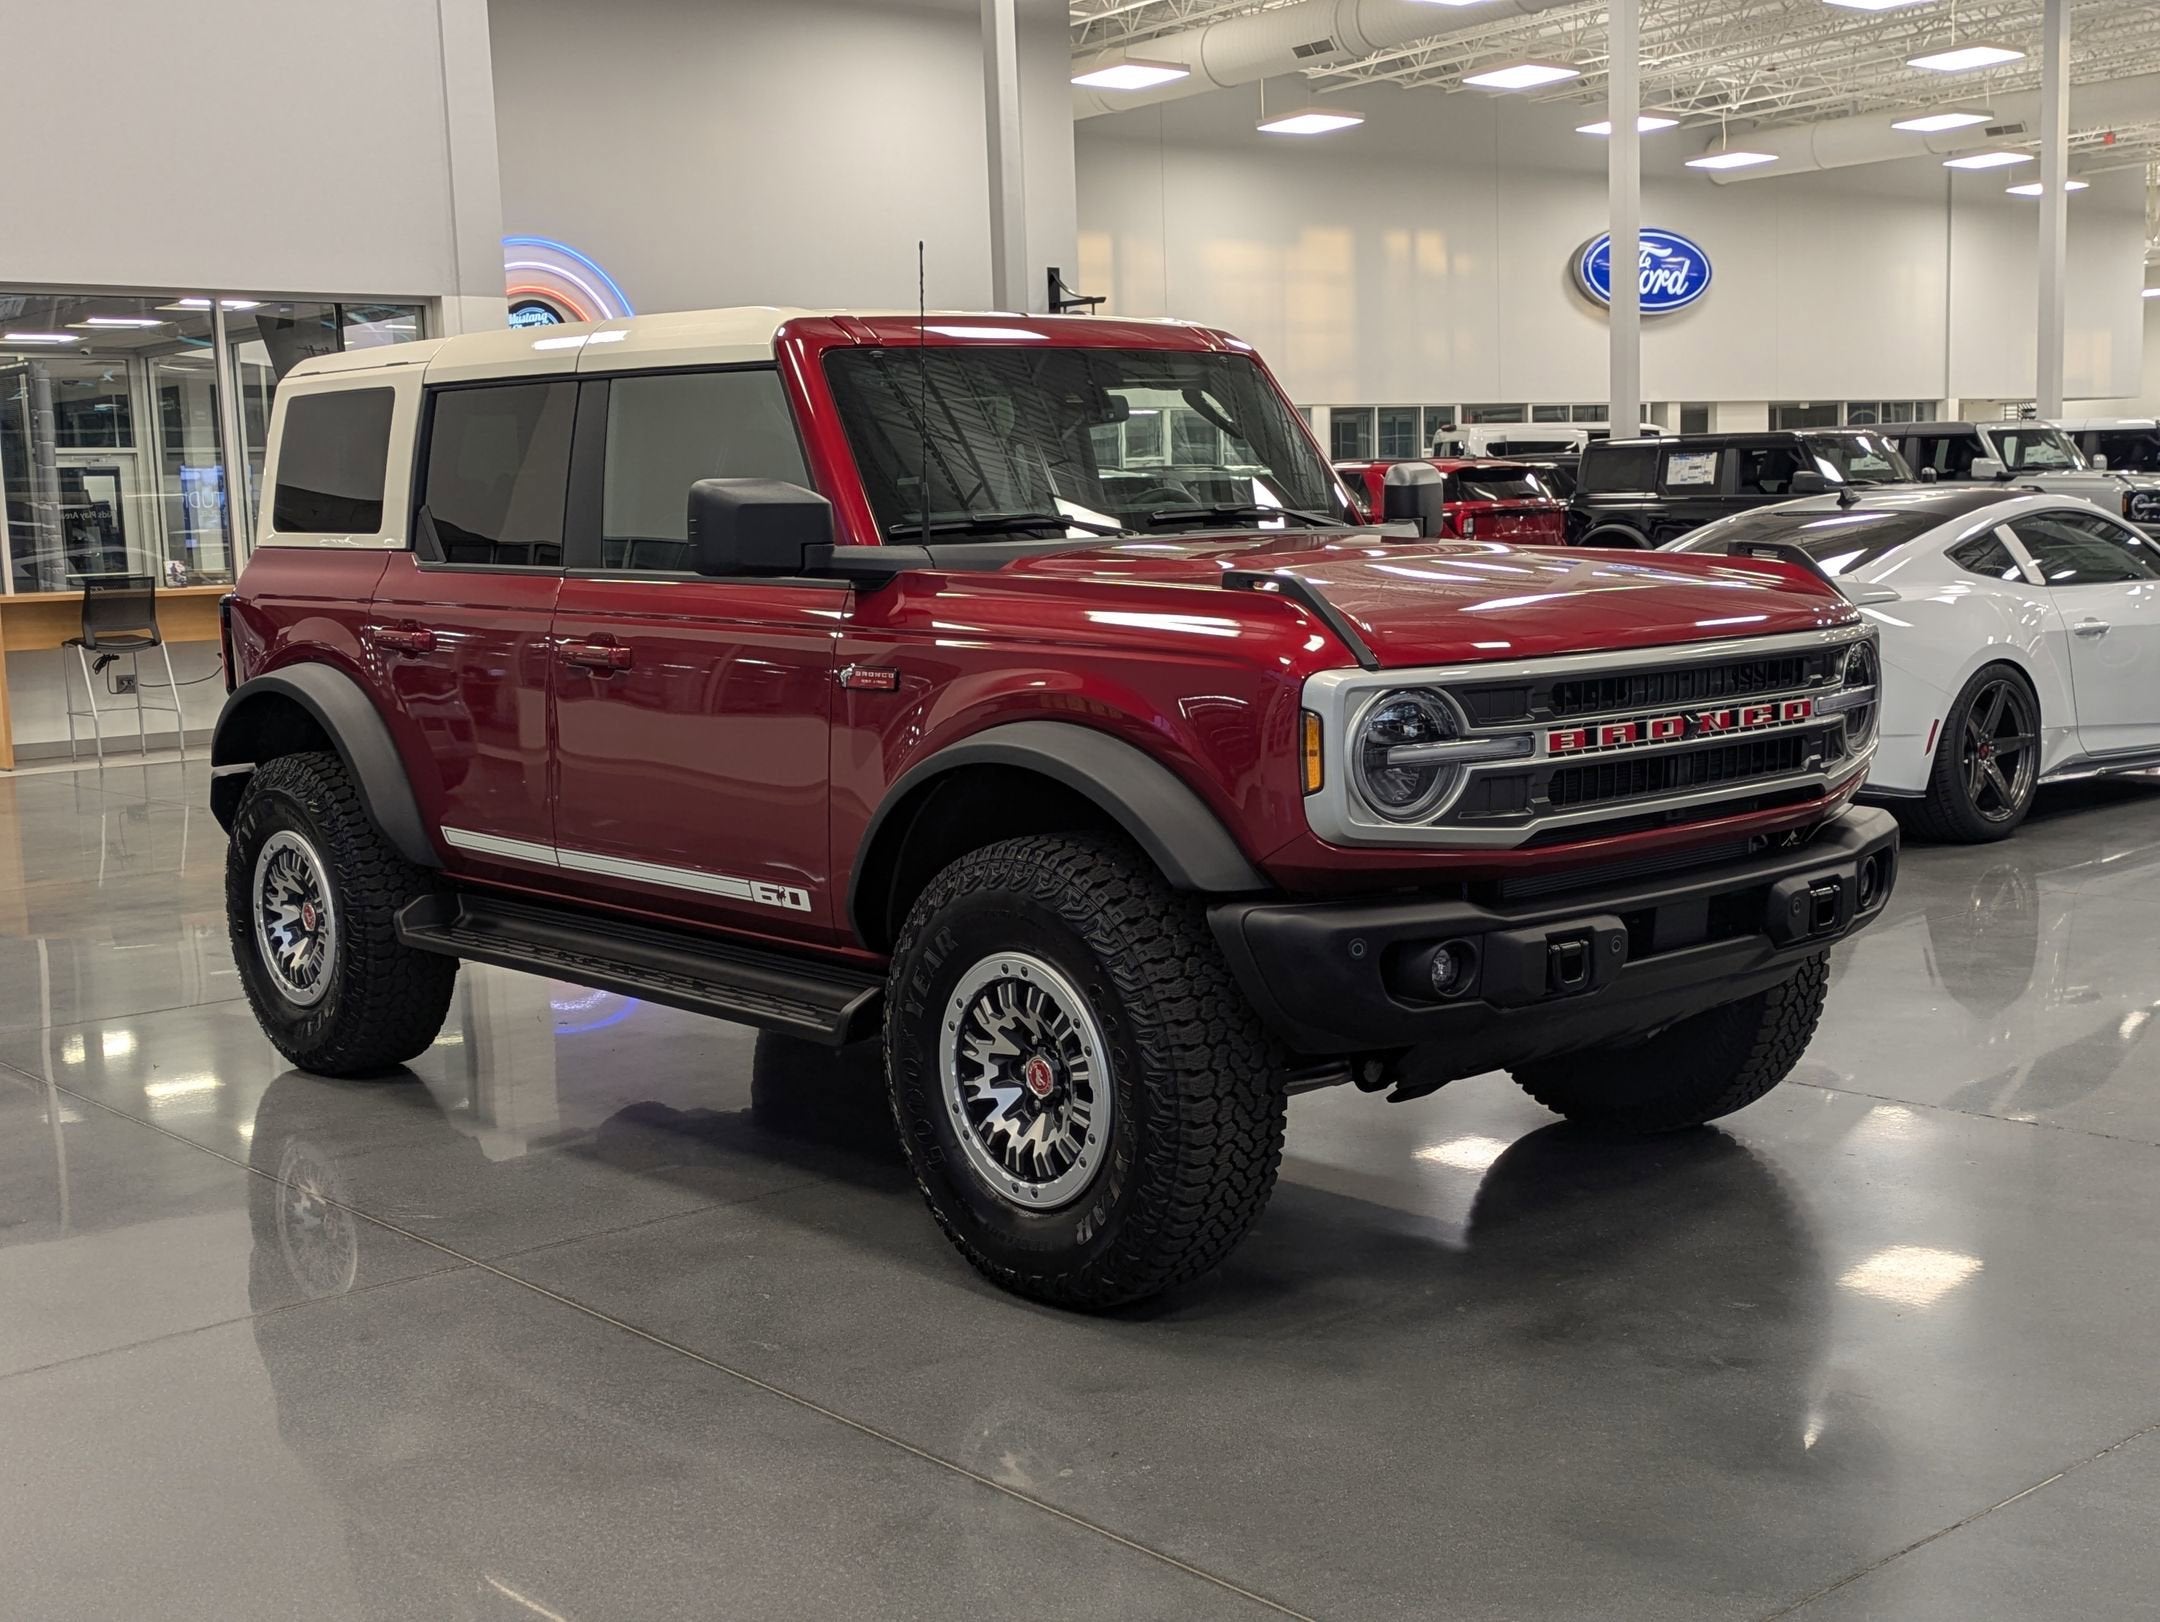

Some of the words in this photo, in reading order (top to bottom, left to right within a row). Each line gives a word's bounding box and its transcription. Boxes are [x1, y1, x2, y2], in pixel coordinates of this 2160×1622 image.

[855, 670, 895, 679] BRONCO
[1545, 698, 1812, 753] BRONCO
[750, 880, 812, 912] 60
